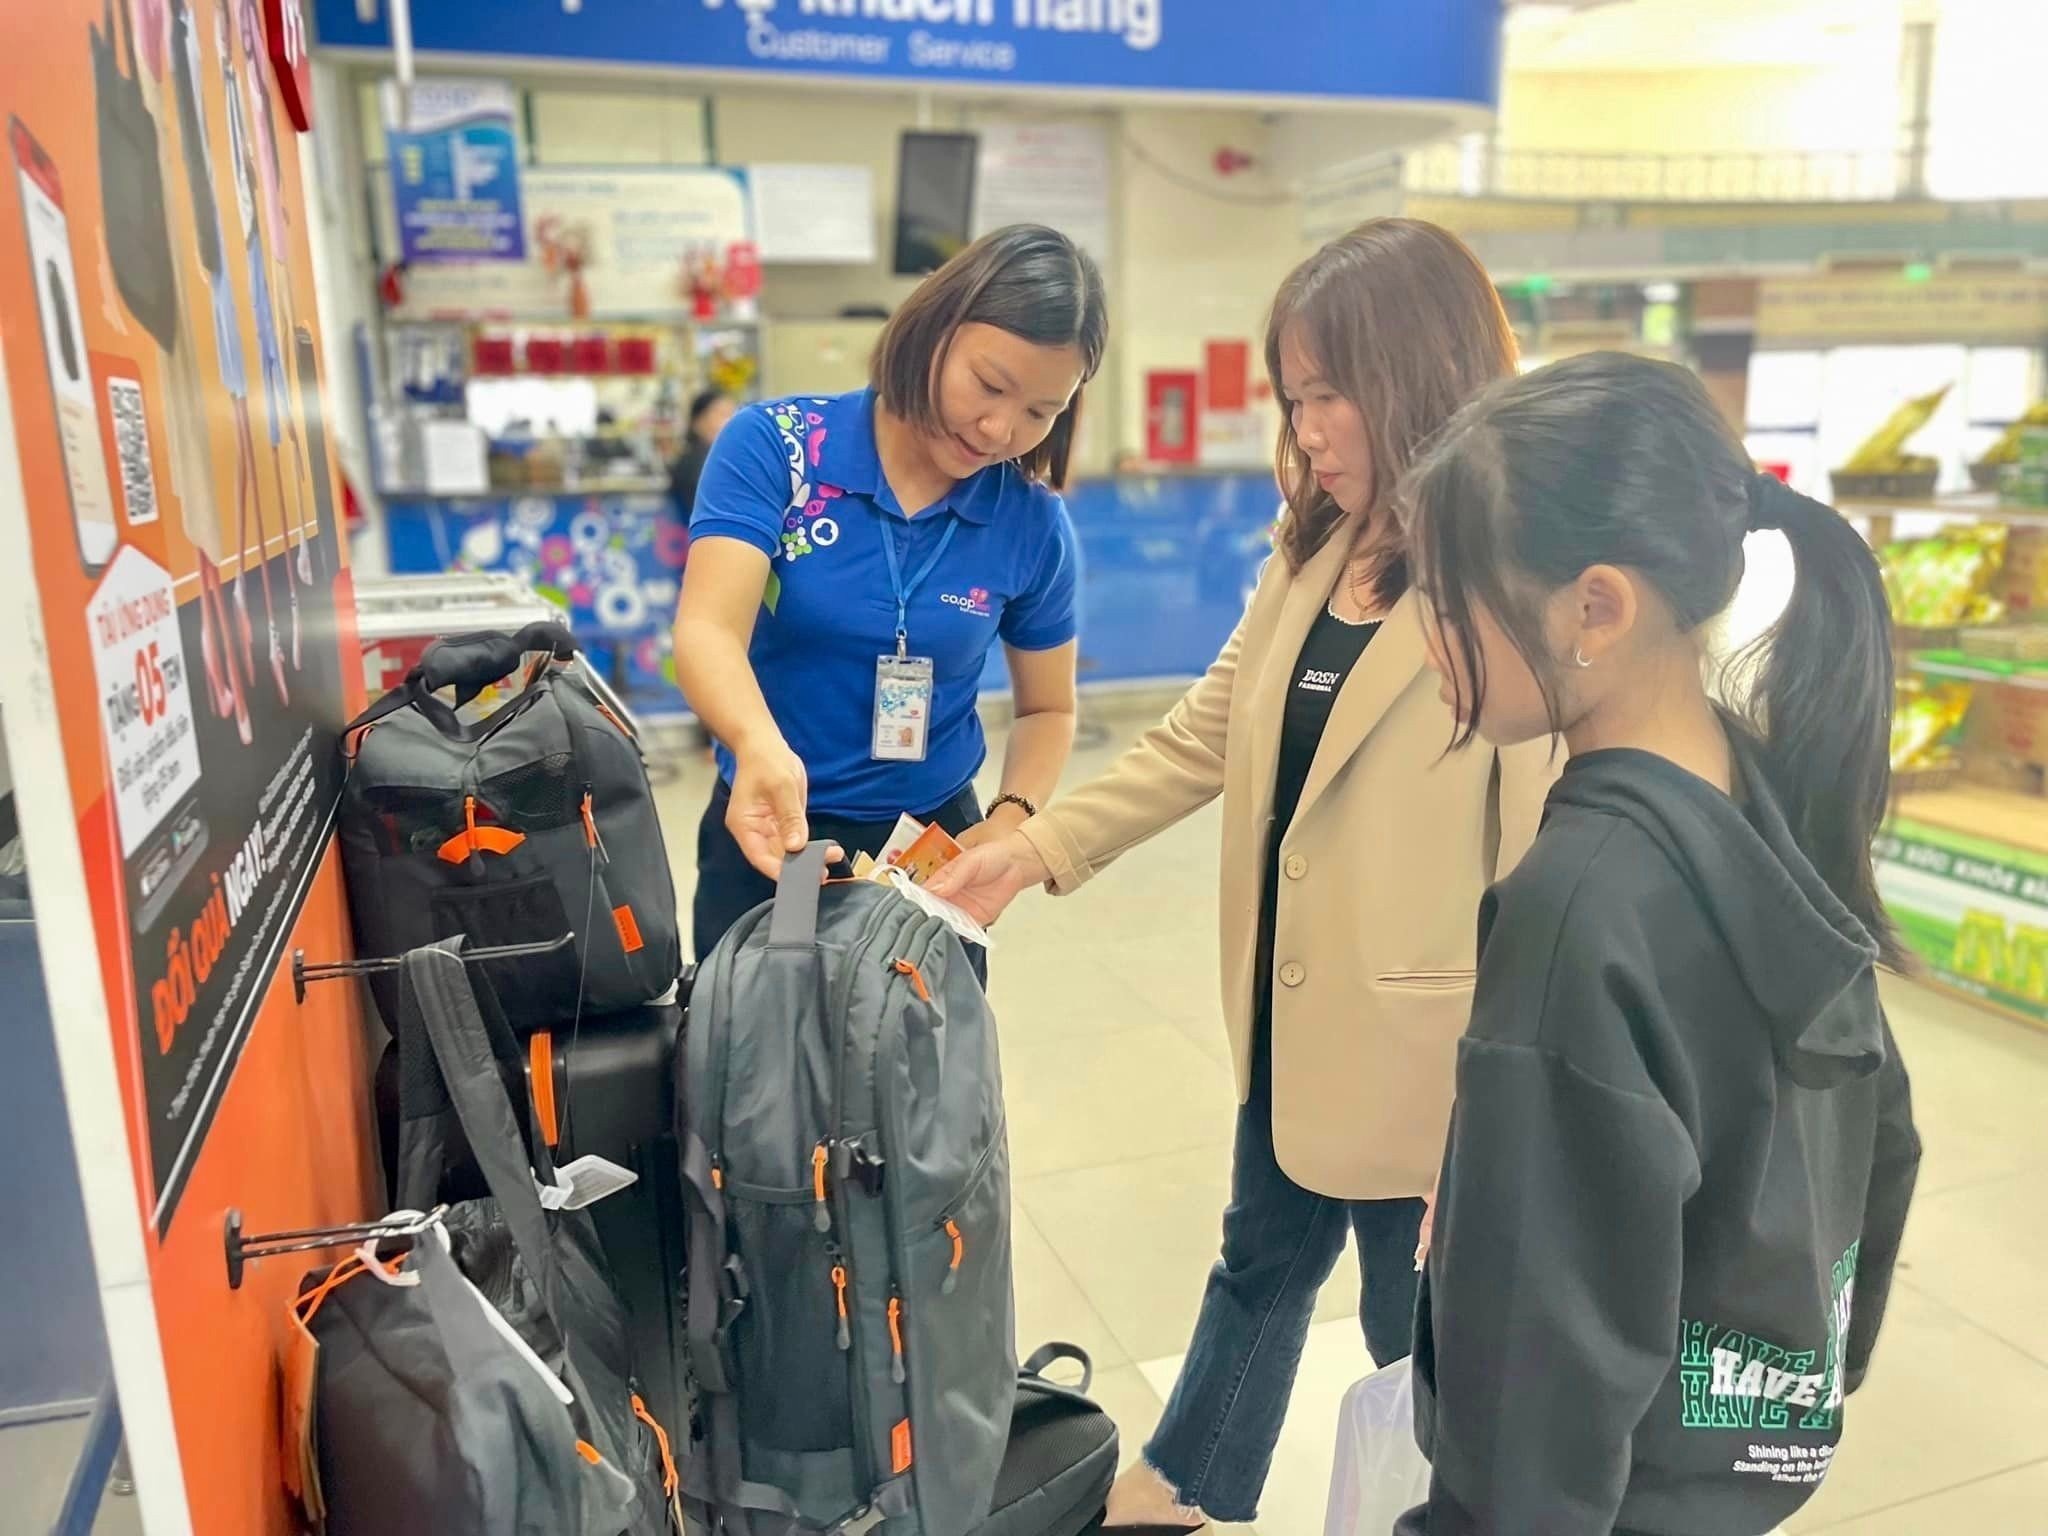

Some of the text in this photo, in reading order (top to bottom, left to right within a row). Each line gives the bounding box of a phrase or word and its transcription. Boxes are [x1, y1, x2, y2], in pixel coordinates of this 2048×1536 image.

[747, 21, 1016, 71] Customer Service
[136, 640, 167, 726] 05
[1711, 1347, 1827, 1409] HAVE
[1733, 1460, 1780, 1474] Standing
[1781, 1463, 1795, 1472] on
[1797, 1461, 1813, 1472] the
[1748, 1445, 1788, 1460] Shining
[1790, 1445, 1808, 1458] like
[1809, 1449, 1817, 1458] a
